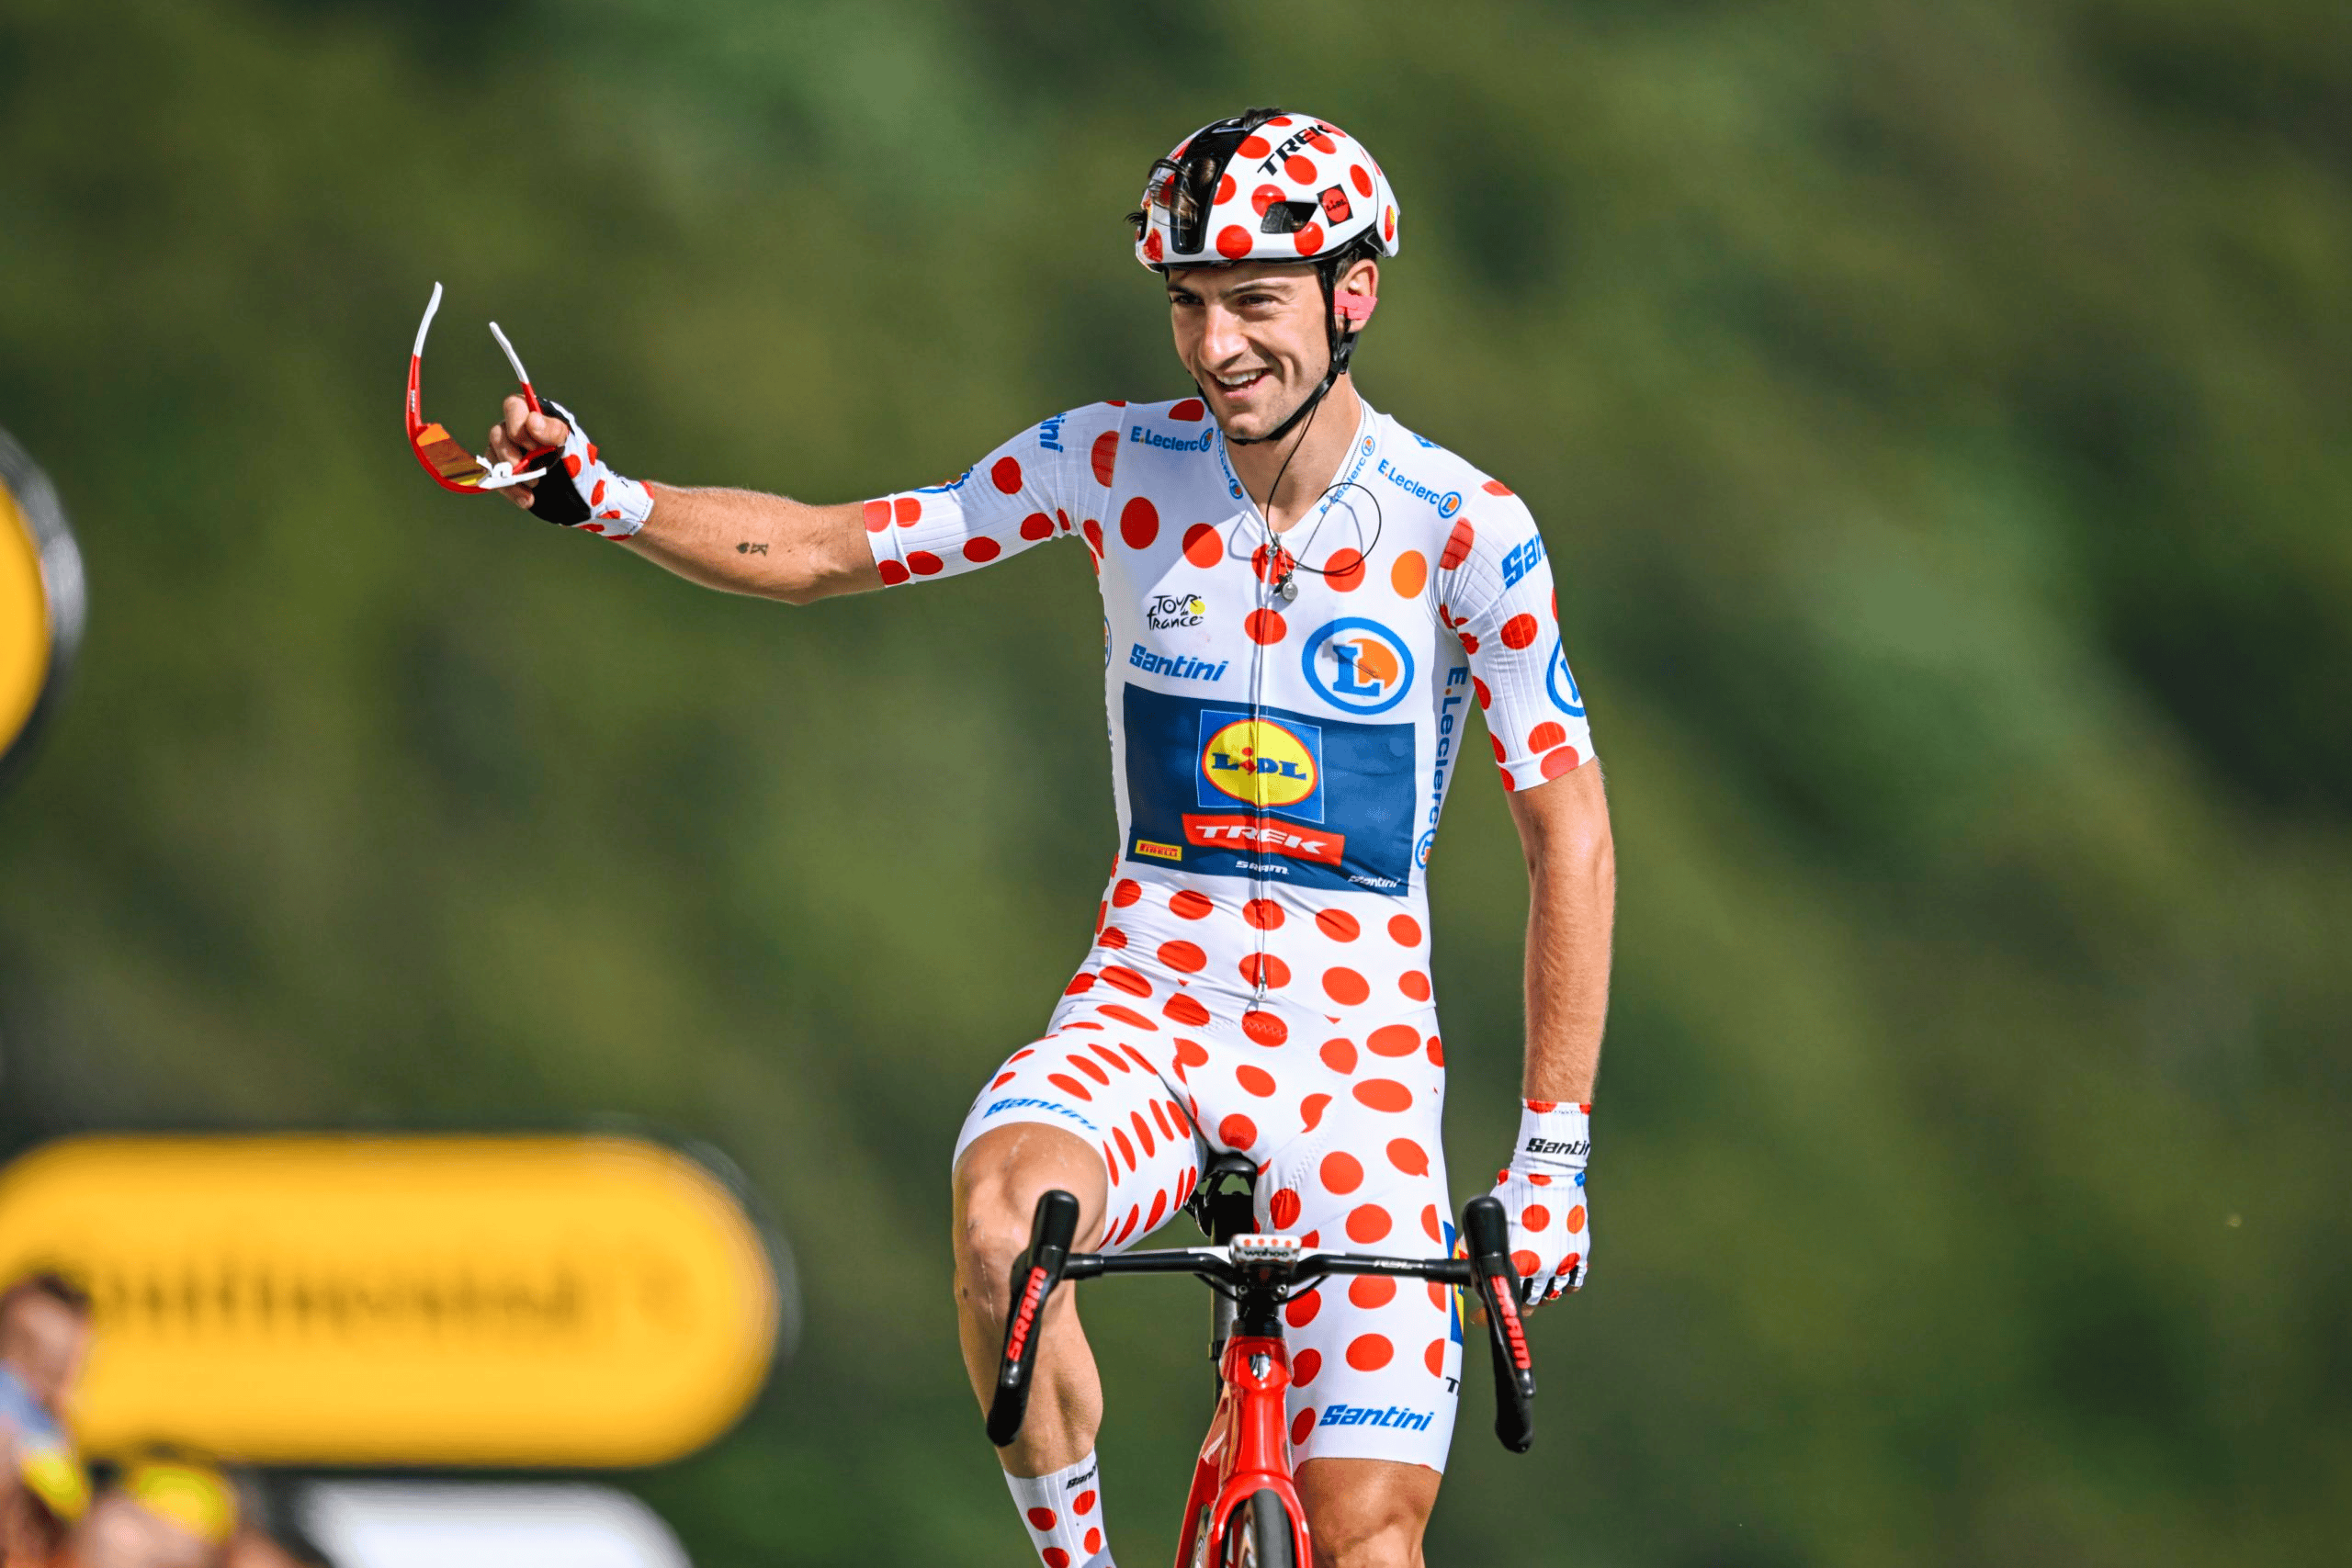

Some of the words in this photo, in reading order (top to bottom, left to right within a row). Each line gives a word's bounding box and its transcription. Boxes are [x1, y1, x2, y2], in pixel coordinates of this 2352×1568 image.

[1257, 124, 1332, 175] TREK
[1130, 425, 1199, 452] E.Leclerc
[1377, 458, 1441, 505] E.Leclerc
[1129, 642, 1229, 682] Santini
[1138, 841, 1179, 858] PIRELLI
[1195, 825, 1329, 855] TREK
[1347, 874, 1402, 889] Santini
[1244, 1247, 1290, 1257] wahoo
[1007, 1265, 1048, 1363] SRAM
[1490, 1275, 1532, 1371] SRAM
[1318, 1404, 1435, 1431] Santini
